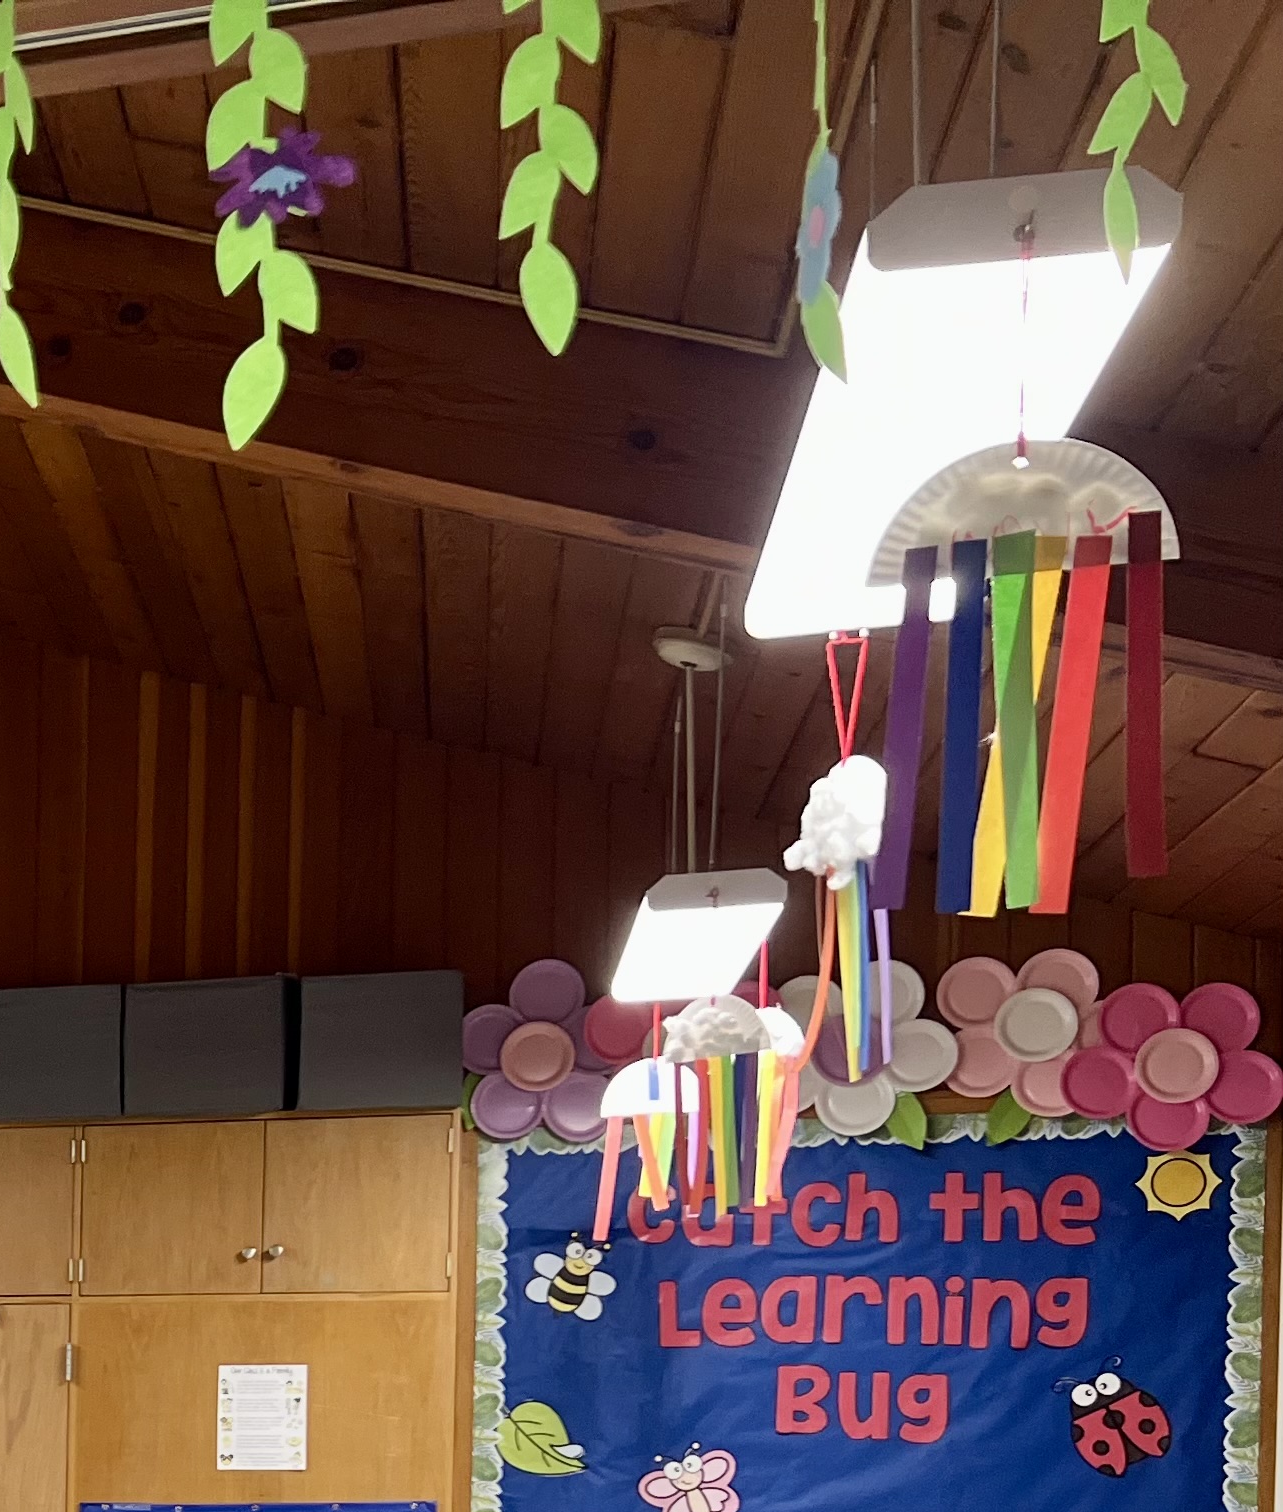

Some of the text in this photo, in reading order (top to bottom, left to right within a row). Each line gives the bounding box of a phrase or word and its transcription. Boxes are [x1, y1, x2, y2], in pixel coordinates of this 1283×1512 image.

[929, 1172, 1102, 1246] the
[658, 1275, 1090, 1350] Learning
[775, 1363, 950, 1444] Bug
